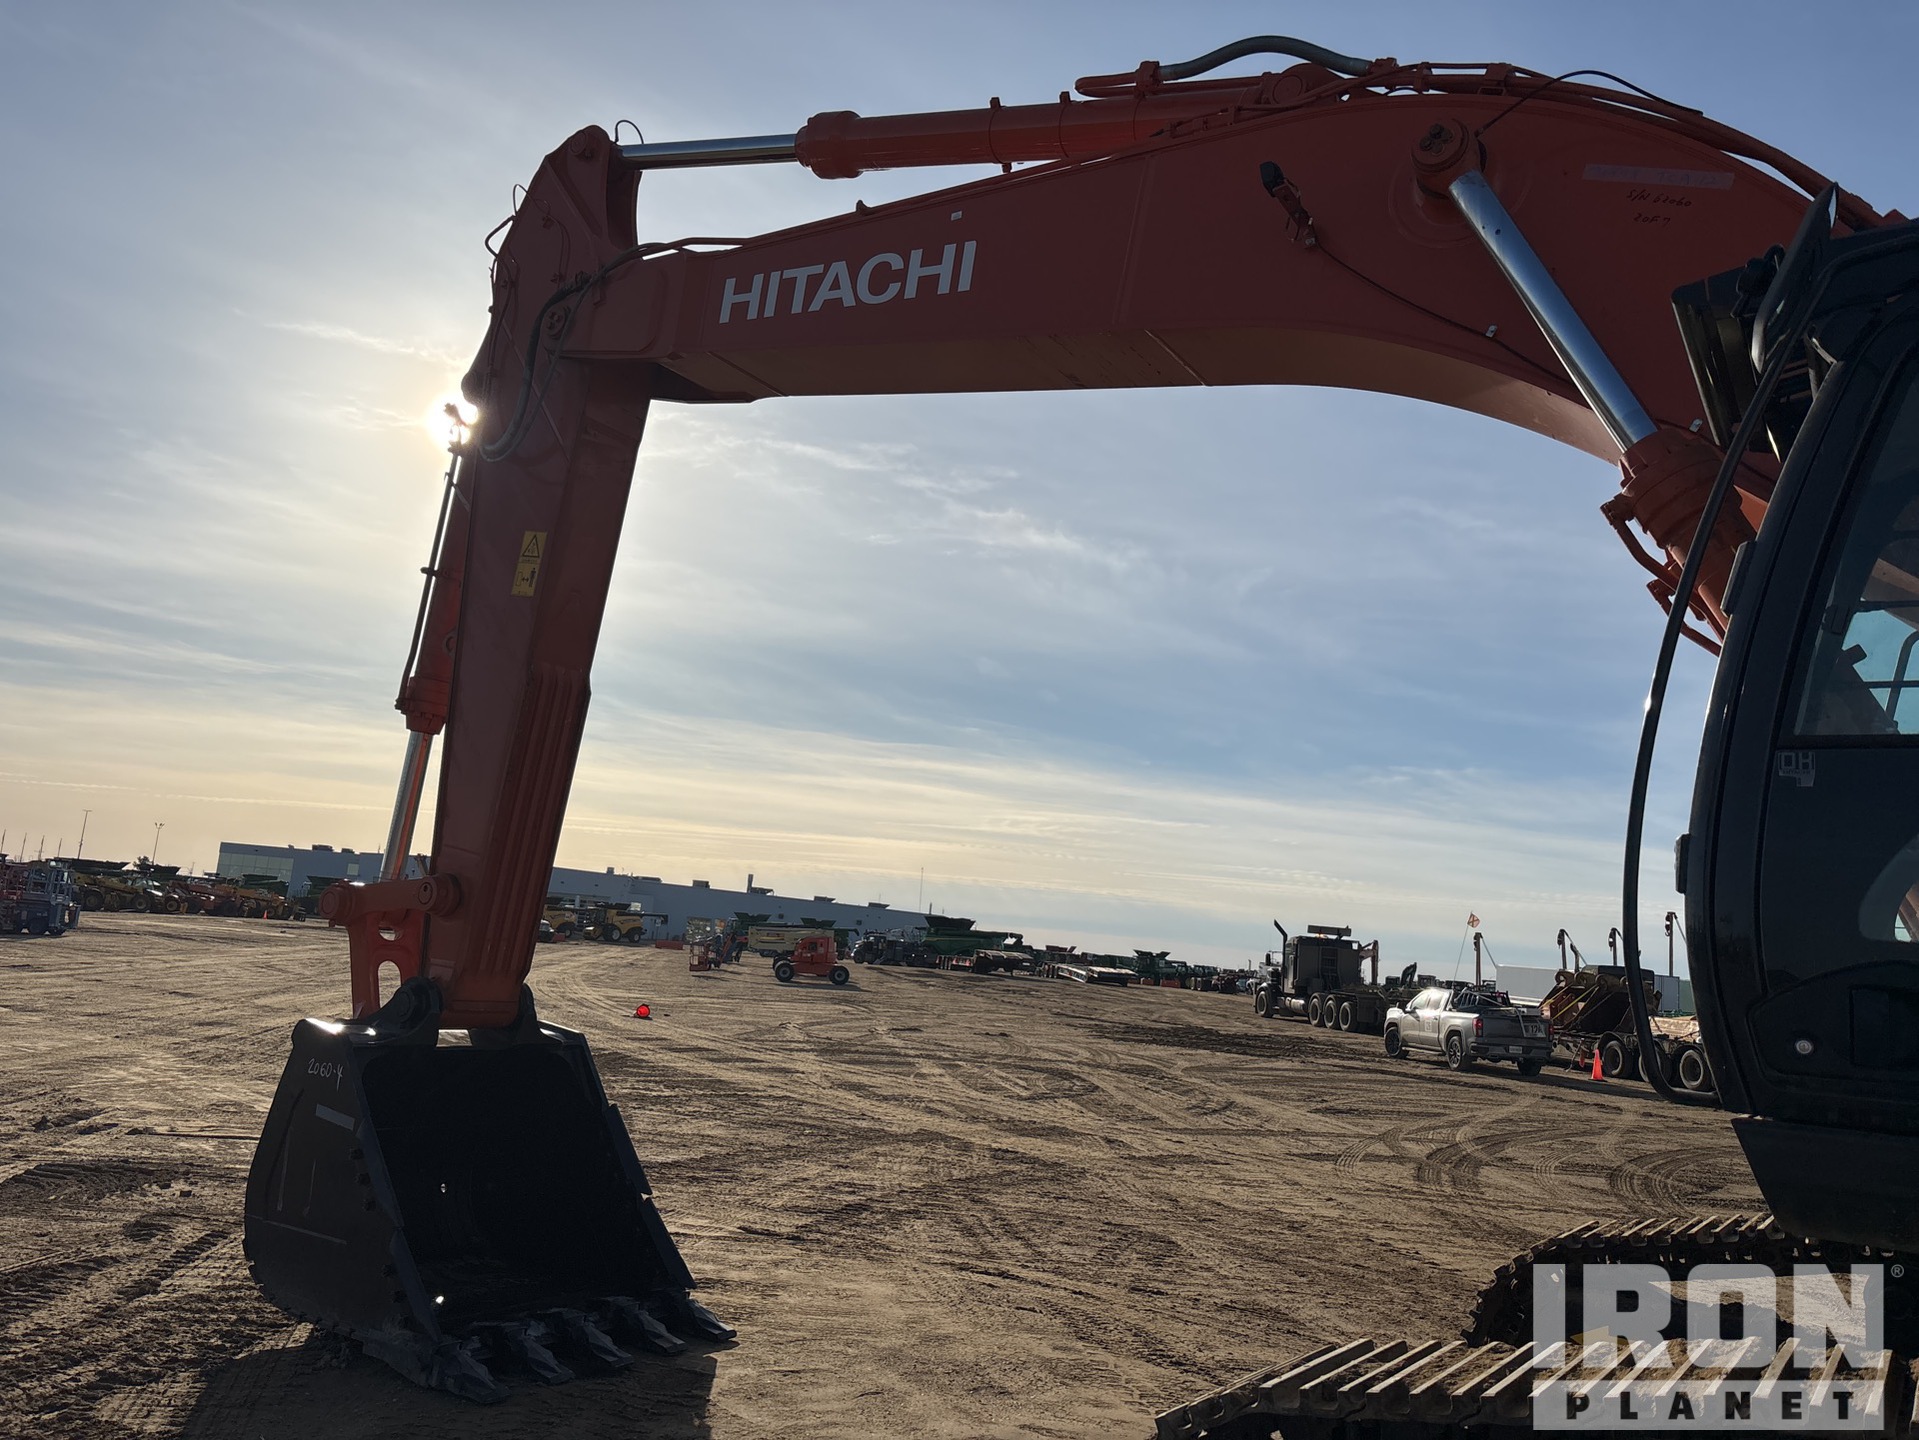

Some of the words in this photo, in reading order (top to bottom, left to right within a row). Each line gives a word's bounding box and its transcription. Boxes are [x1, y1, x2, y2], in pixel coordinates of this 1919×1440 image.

[1626, 188, 1650, 202] S/N
[1653, 193, 1693, 207] 62060
[718, 240, 977, 325] HITACHI
